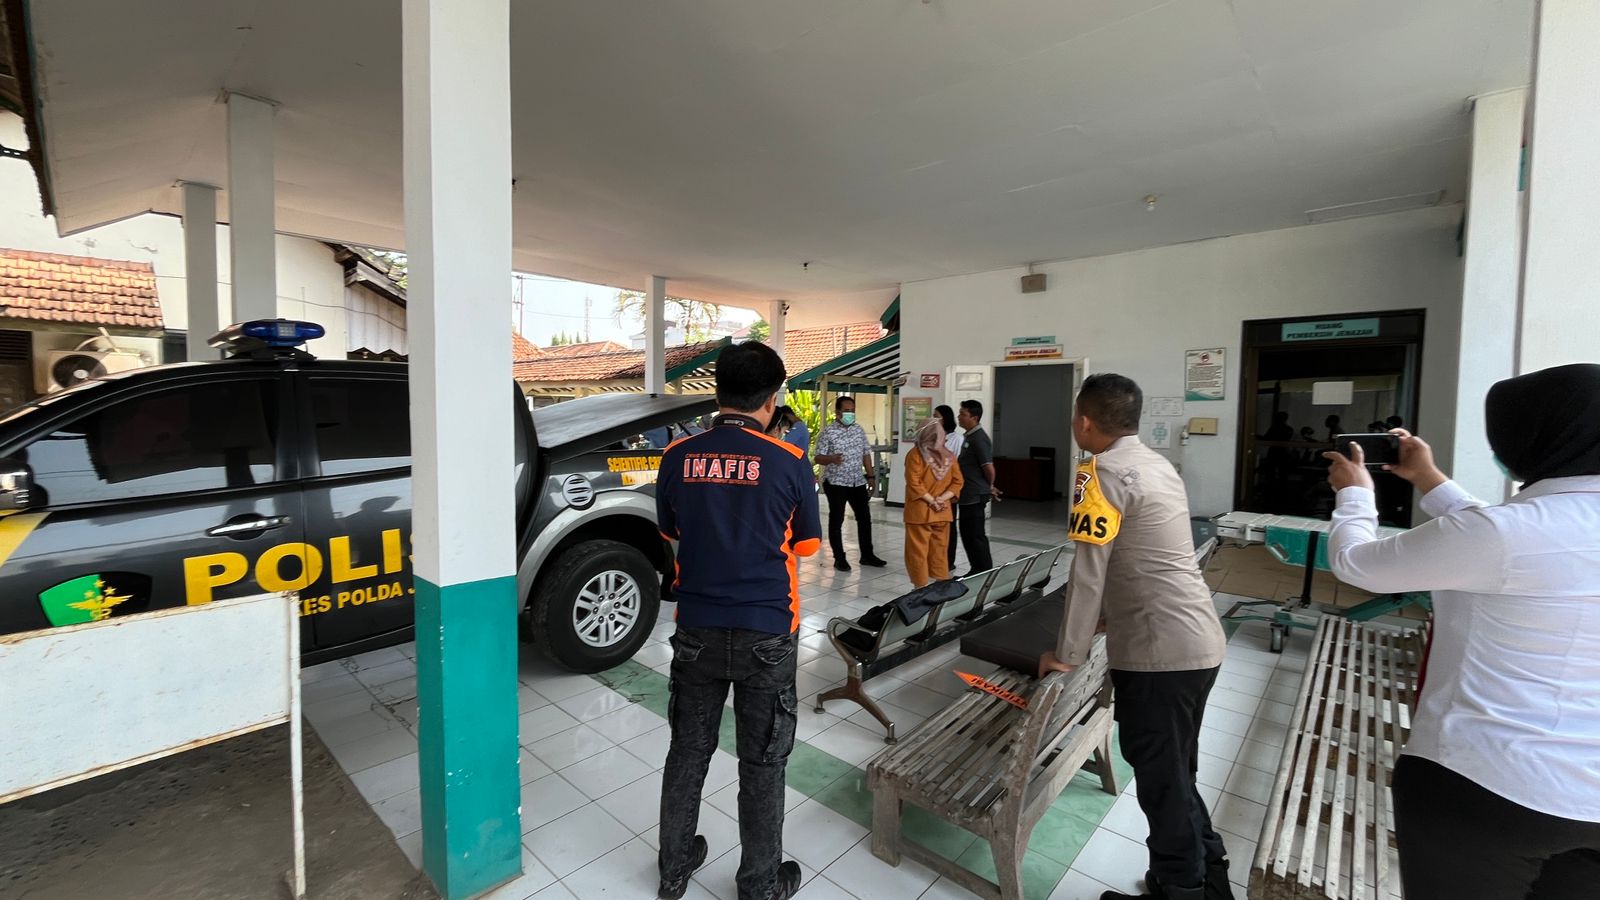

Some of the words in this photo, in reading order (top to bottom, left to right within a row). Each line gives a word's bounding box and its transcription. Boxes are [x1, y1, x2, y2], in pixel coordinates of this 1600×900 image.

[607, 456, 649, 473] SCIENTIFIC
[683, 458, 760, 481] INAFIS
[183, 528, 414, 606] POLI
[337, 581, 404, 609] POLDA
